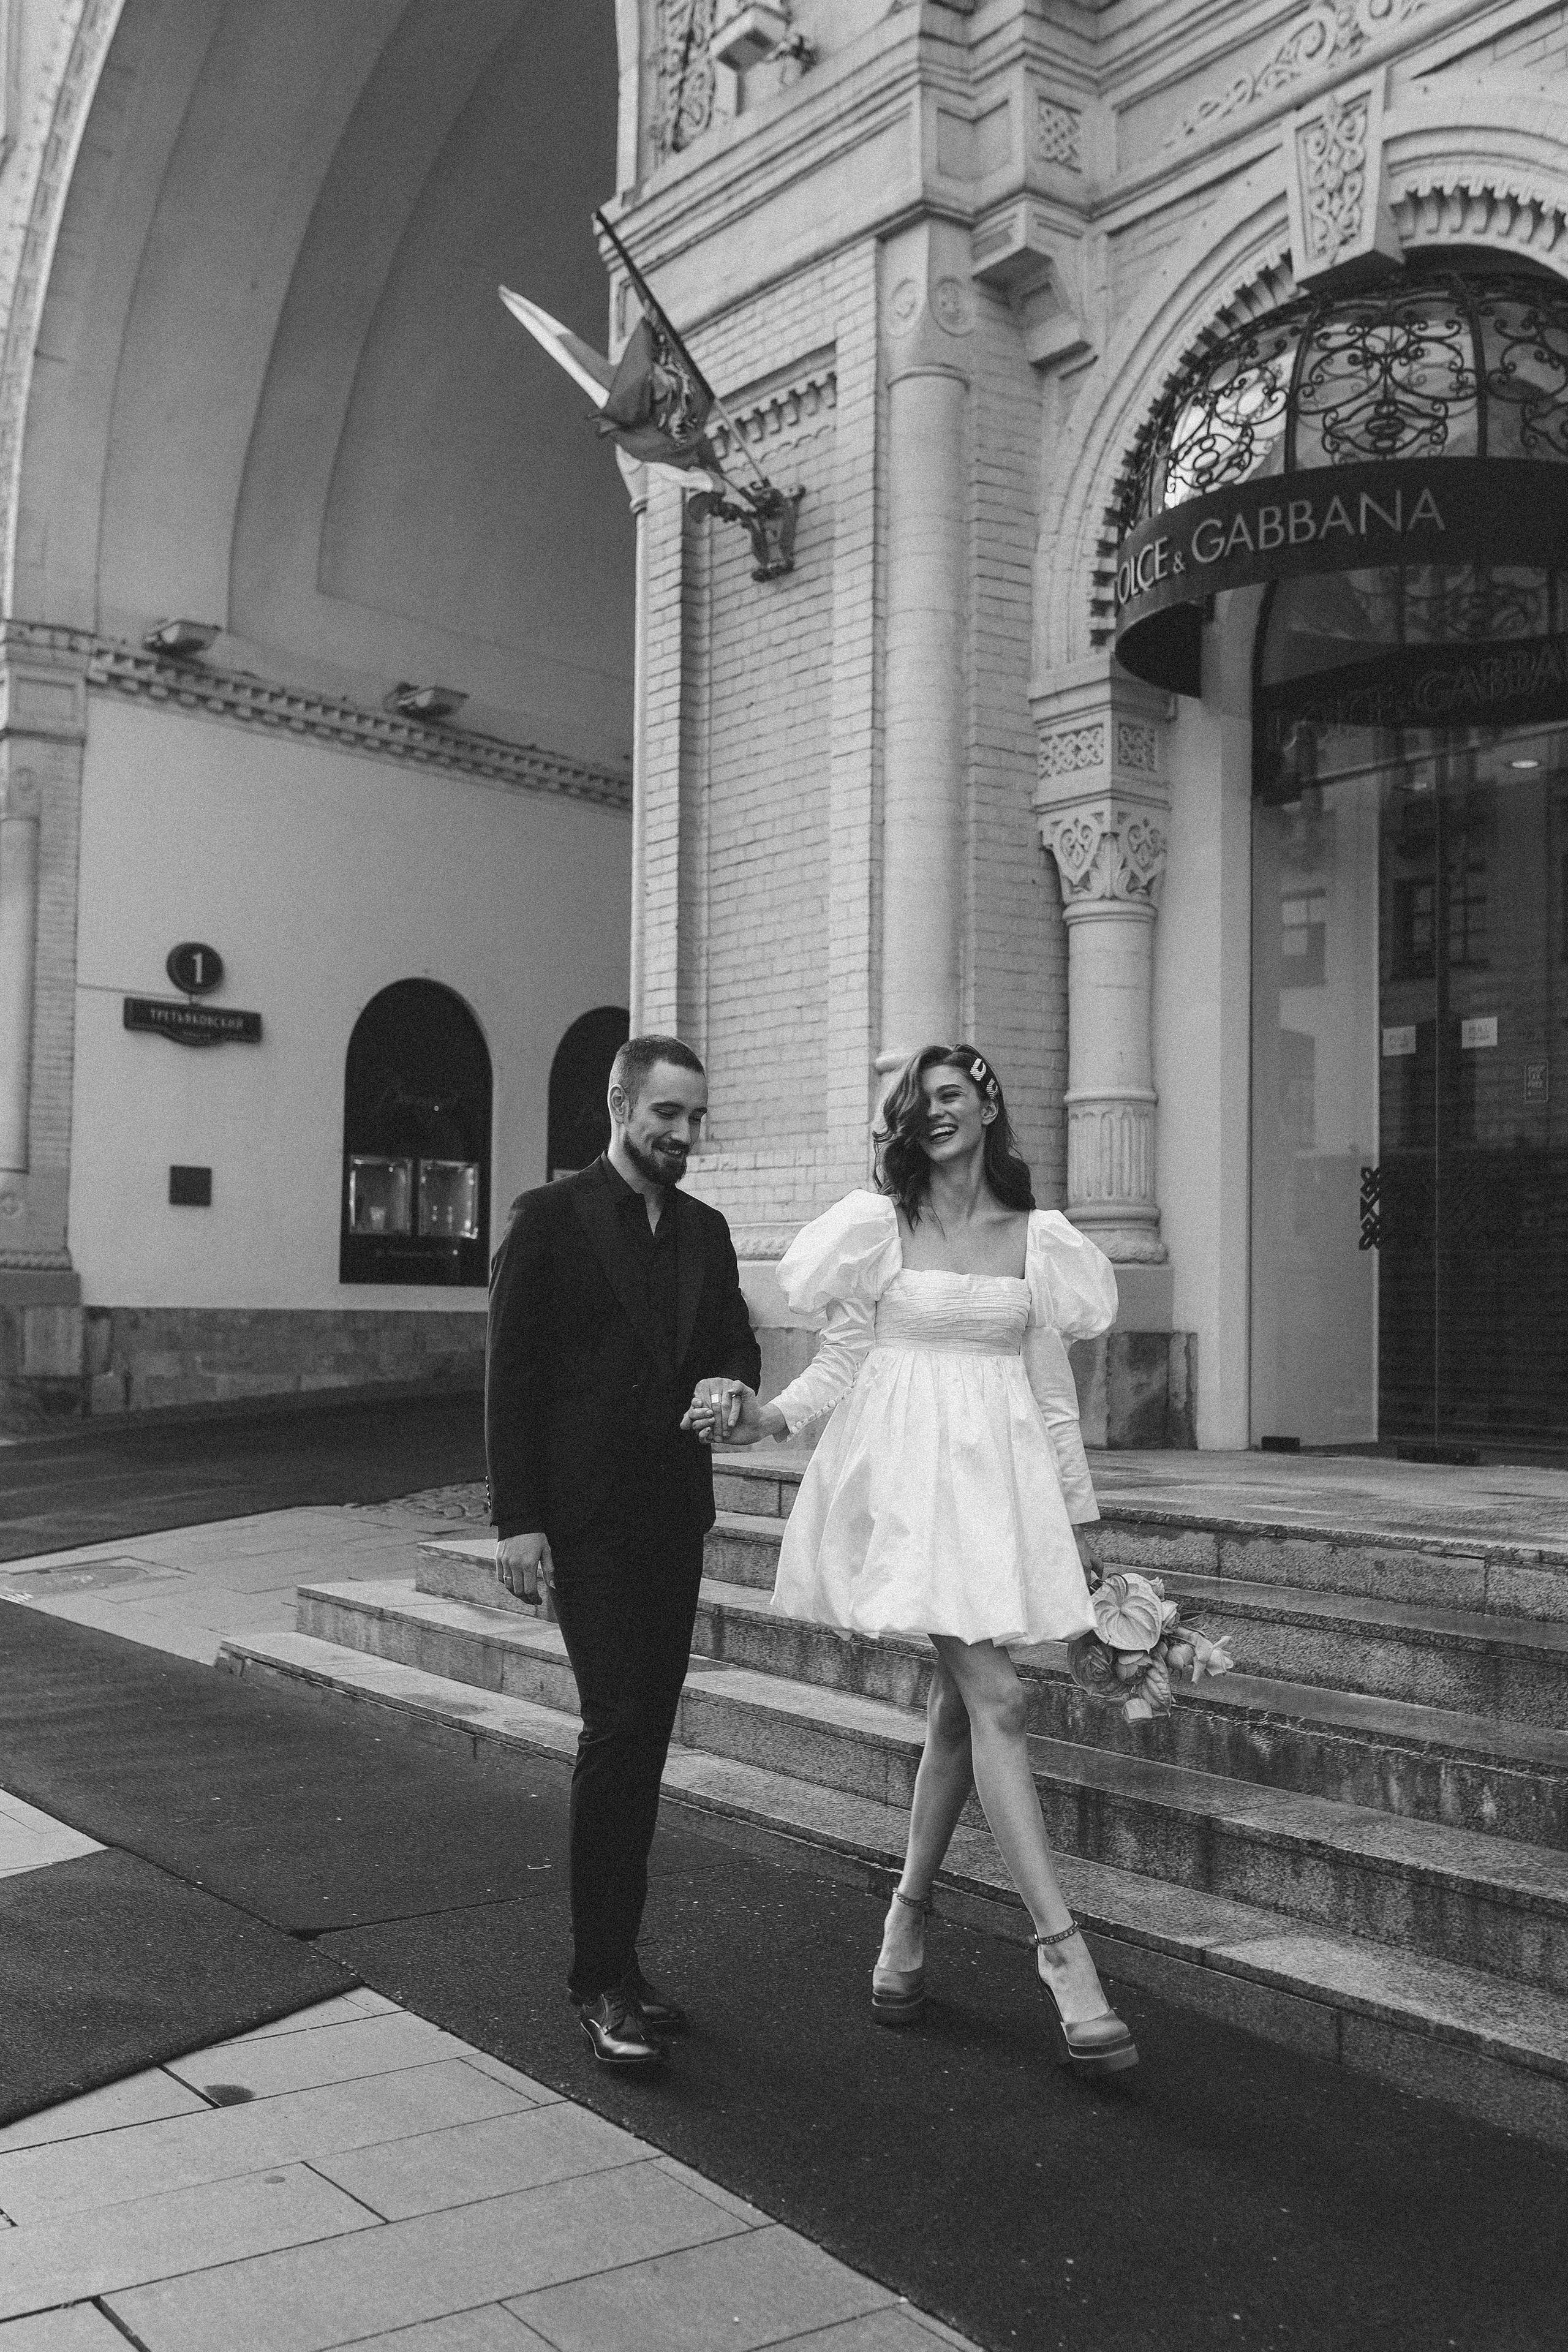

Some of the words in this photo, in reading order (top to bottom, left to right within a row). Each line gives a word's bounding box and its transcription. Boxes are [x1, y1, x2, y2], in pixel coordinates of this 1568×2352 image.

[1115, 537, 1168, 605] OLCE
[1172, 551, 1186, 574] &
[1191, 488, 1446, 563] GABBANA
[193, 952, 203, 984] 1
